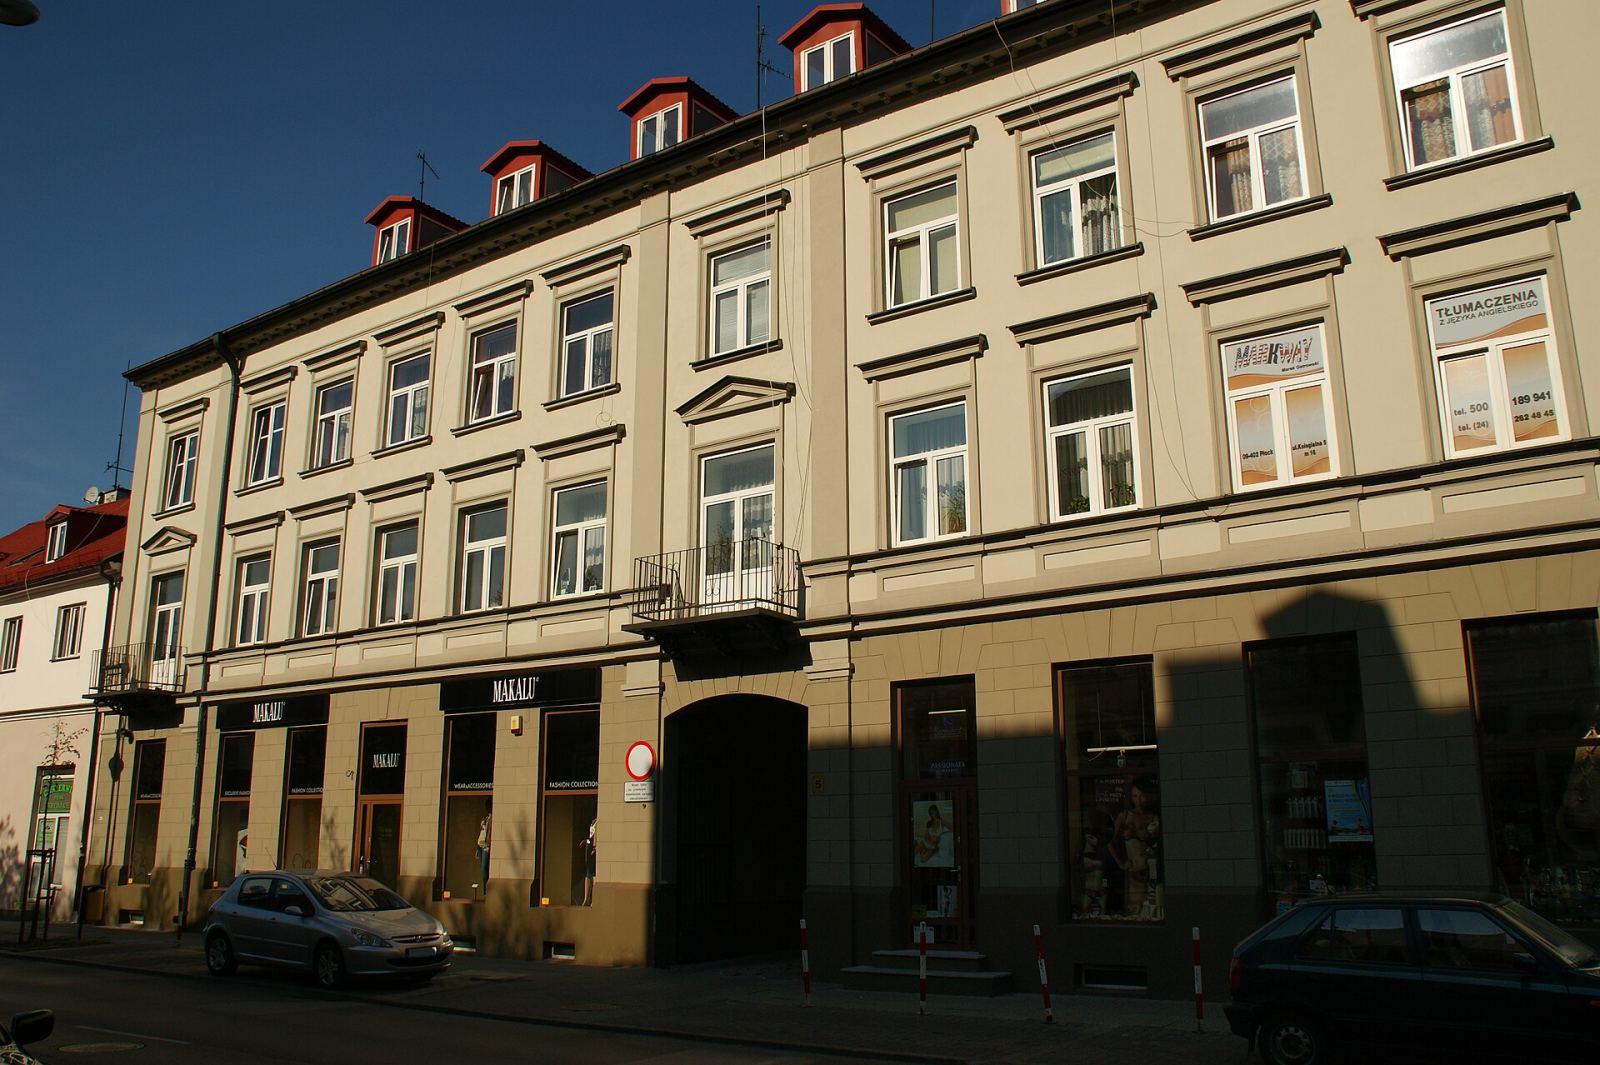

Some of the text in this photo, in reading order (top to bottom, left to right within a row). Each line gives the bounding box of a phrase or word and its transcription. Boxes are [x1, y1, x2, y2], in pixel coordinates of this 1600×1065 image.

[1435, 289, 1538, 319] TŁUMACZENIA
[1446, 314, 1476, 325] JĘZYKA
[1477, 300, 1539, 318] ANGIELSKIEGO
[1233, 337, 1313, 372] MARKWAY
[1512, 390, 1552, 406] 189 941
[1453, 402, 1489, 417] tel. 500
[1514, 409, 1555, 423] 262 48 45
[1458, 420, 1489, 432] tel. (24)
[1242, 451, 1259, 460] 09-402
[492, 676, 537, 704] MAKALU
[252, 701, 284, 723] MAKALU
[372, 753, 400, 769] MAKALU
[549, 781, 570, 789] FASHION
[815, 779, 822, 789] 5
